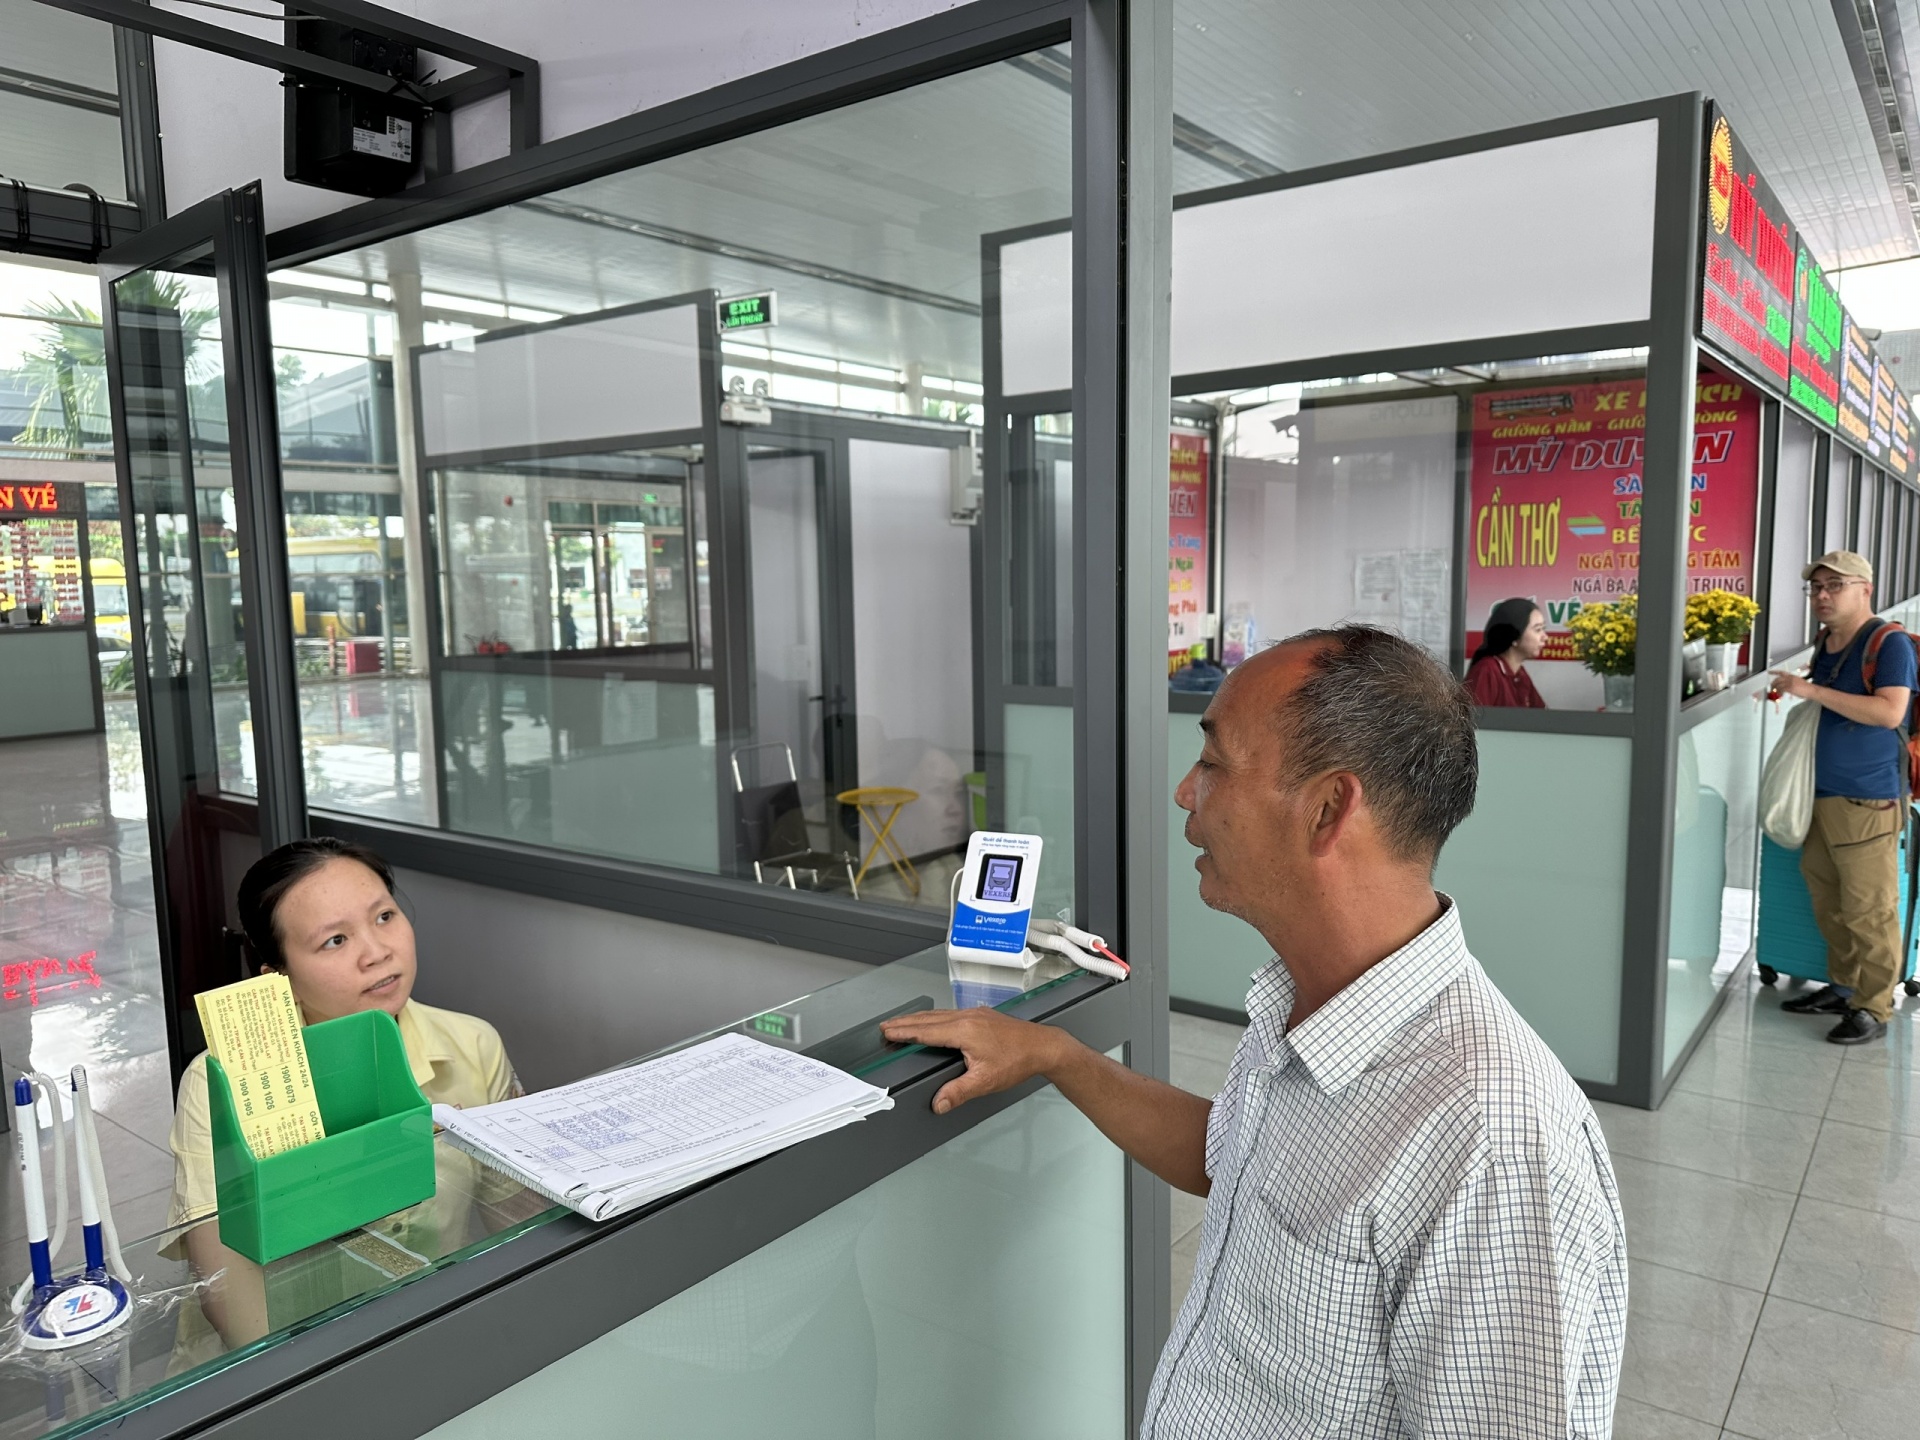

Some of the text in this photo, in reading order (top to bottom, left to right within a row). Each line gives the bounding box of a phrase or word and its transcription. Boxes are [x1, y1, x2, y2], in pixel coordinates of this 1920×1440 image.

[729, 298, 760, 315] EXIT
[1595, 392, 1630, 411] XE
[20, 482, 58, 510] VÉ
[1477, 486, 1561, 568] CẦN THƠ
[1703, 549, 1740, 569] TÂM
[292, 1039, 306, 1068] KHÁCH
[299, 1068, 310, 1088] 24/24
[237, 1076, 254, 1116] 1900 1905
[258, 1070, 275, 1110] 1900 1026
[280, 1065, 296, 1104] 1900 6079
